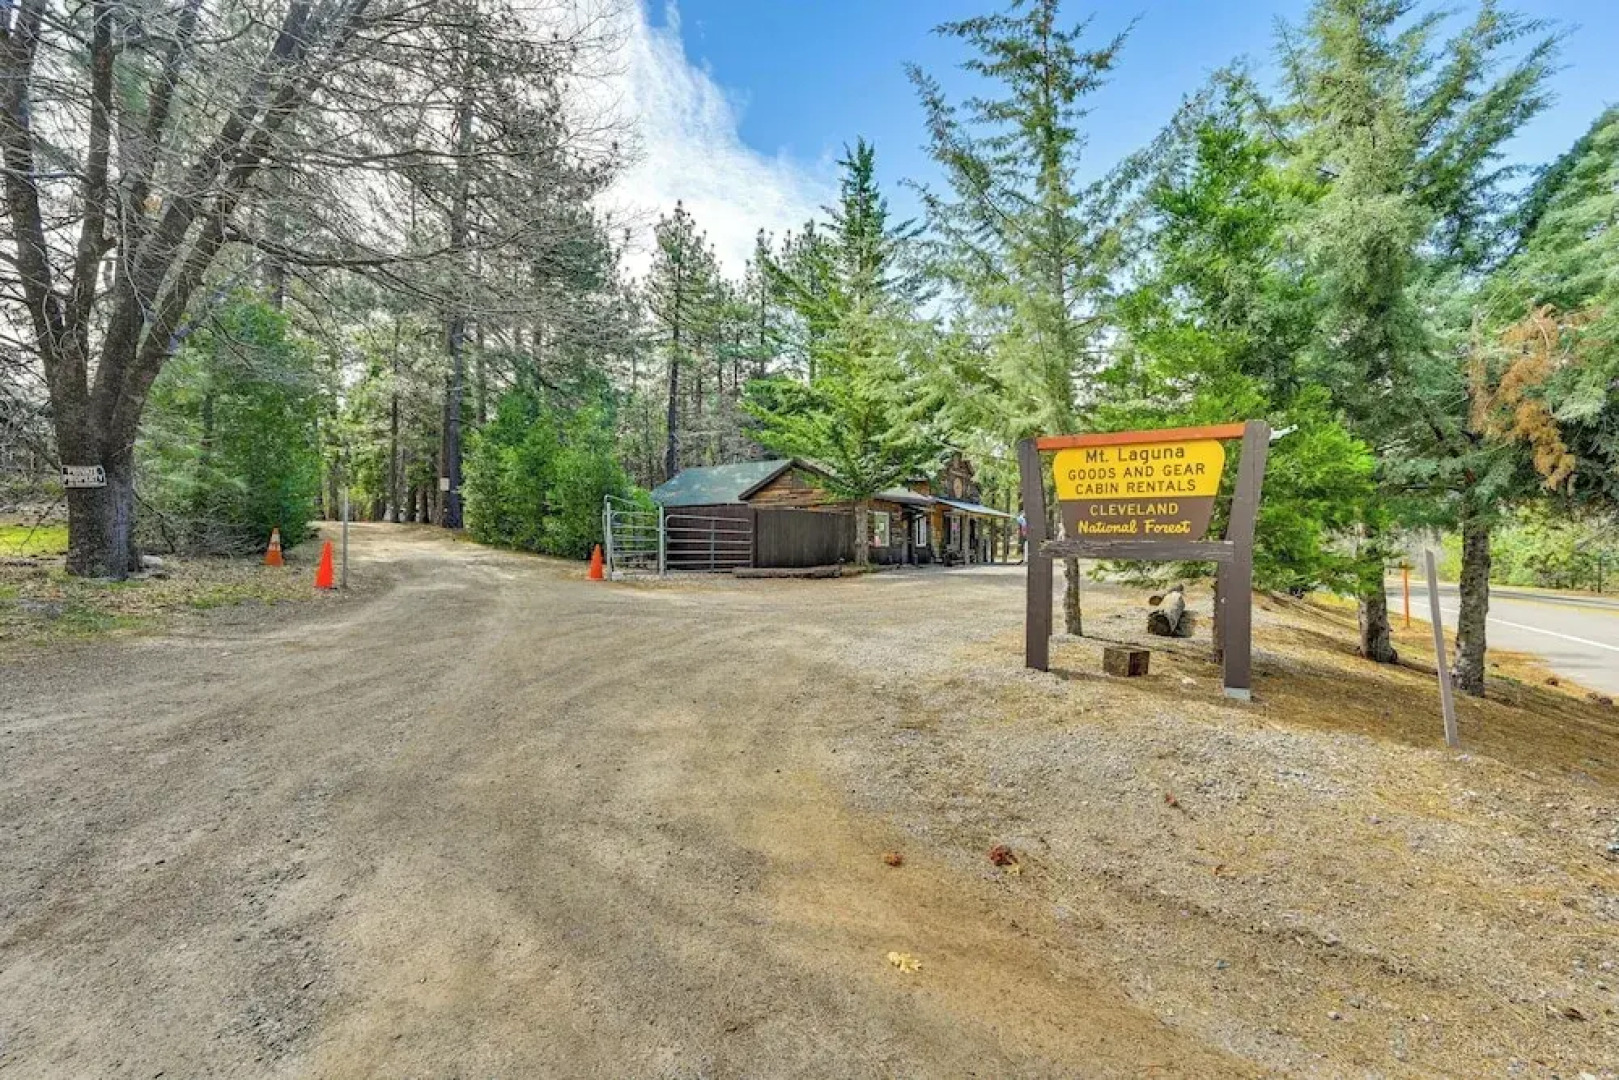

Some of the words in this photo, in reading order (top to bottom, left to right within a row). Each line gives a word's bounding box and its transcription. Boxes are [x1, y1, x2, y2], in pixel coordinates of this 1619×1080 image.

[1086, 449, 1109, 463] Mt.
[1118, 446, 1185, 464] Laguna
[1068, 467, 1116, 481] GOODS
[1123, 465, 1154, 478] AND
[1163, 463, 1205, 477] GEAR
[1075, 482, 1118, 495] CABIN
[1126, 479, 1196, 493] RENTALS
[1089, 503, 1178, 517] CLEVELAND
[1078, 519, 1138, 534] National
[1144, 519, 1191, 533] Forest
